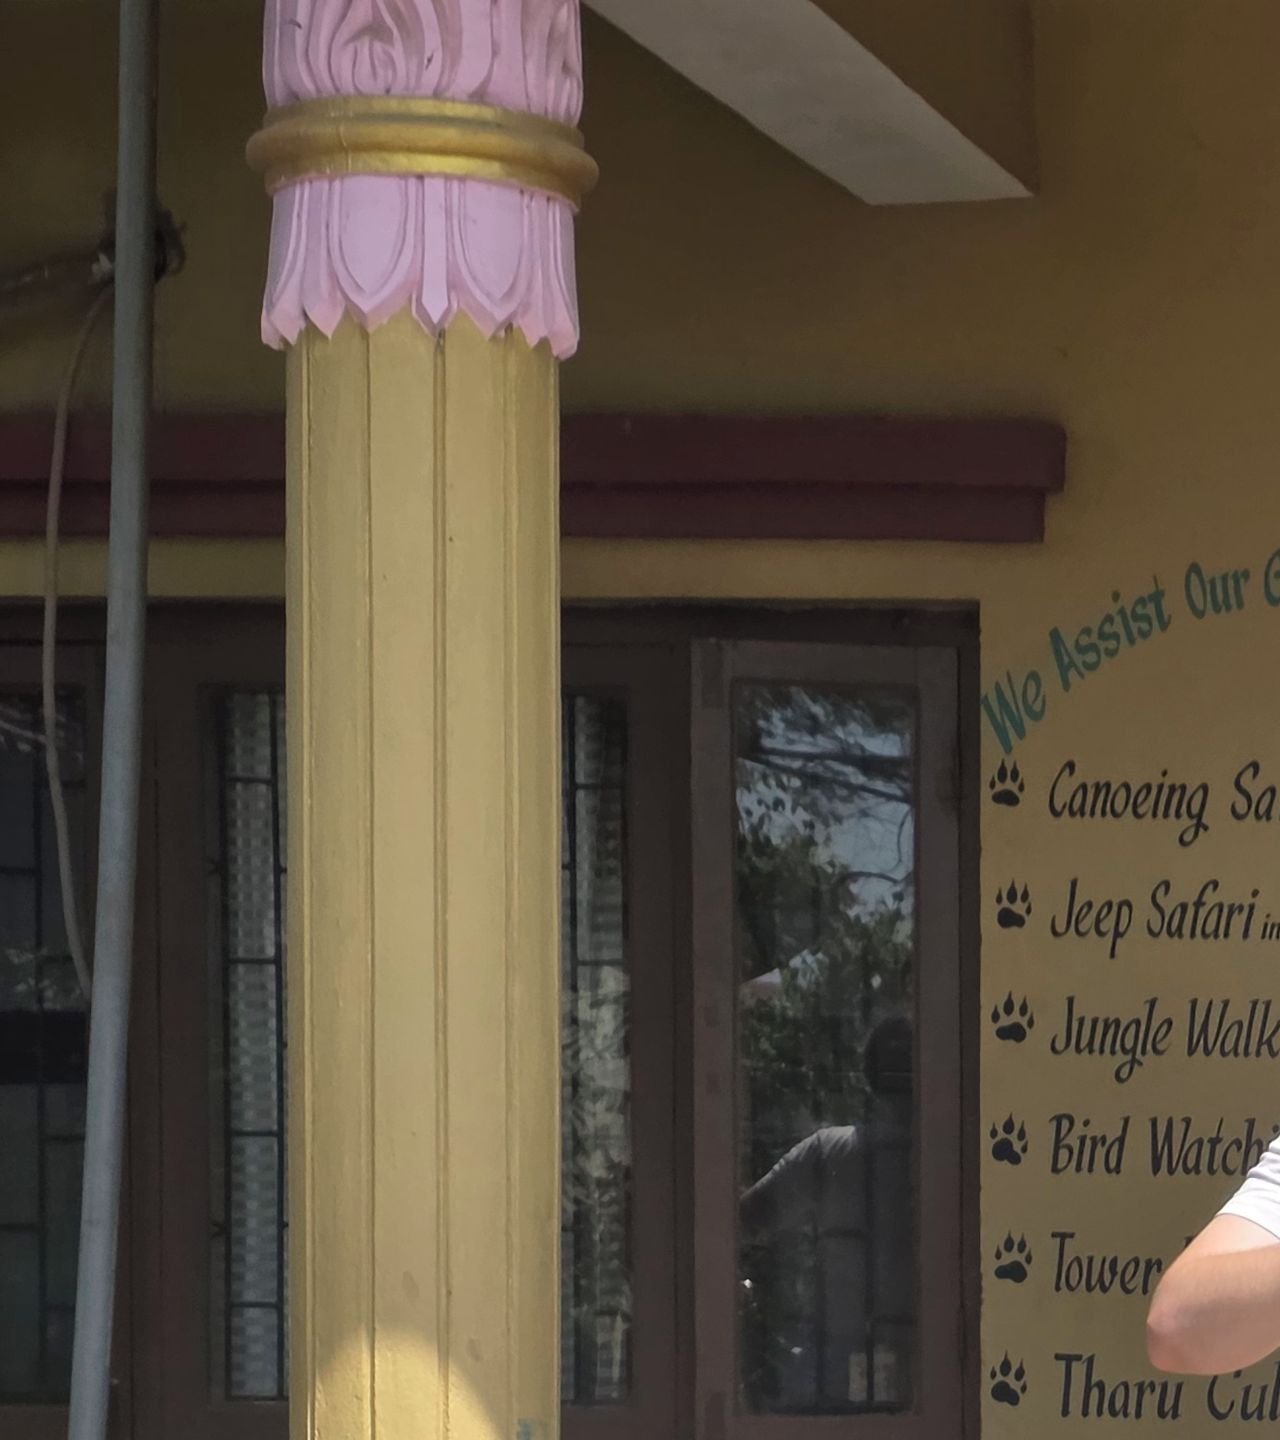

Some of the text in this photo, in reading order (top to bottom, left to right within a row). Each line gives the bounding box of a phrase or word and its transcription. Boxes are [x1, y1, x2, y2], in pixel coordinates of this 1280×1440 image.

[979, 671, 1048, 754] We
[1049, 574, 1172, 692] Assist
[1184, 561, 1249, 619] Our
[1048, 760, 1210, 847] Canoeing
[1050, 877, 1133, 958] Jeep
[1146, 879, 1260, 941] Safari
[1050, 996, 1173, 1084] Jungle
[1048, 1113, 1131, 1175] Bird
[1050, 1231, 1163, 1295] Tower
[1054, 1353, 1185, 1421] Tharu
